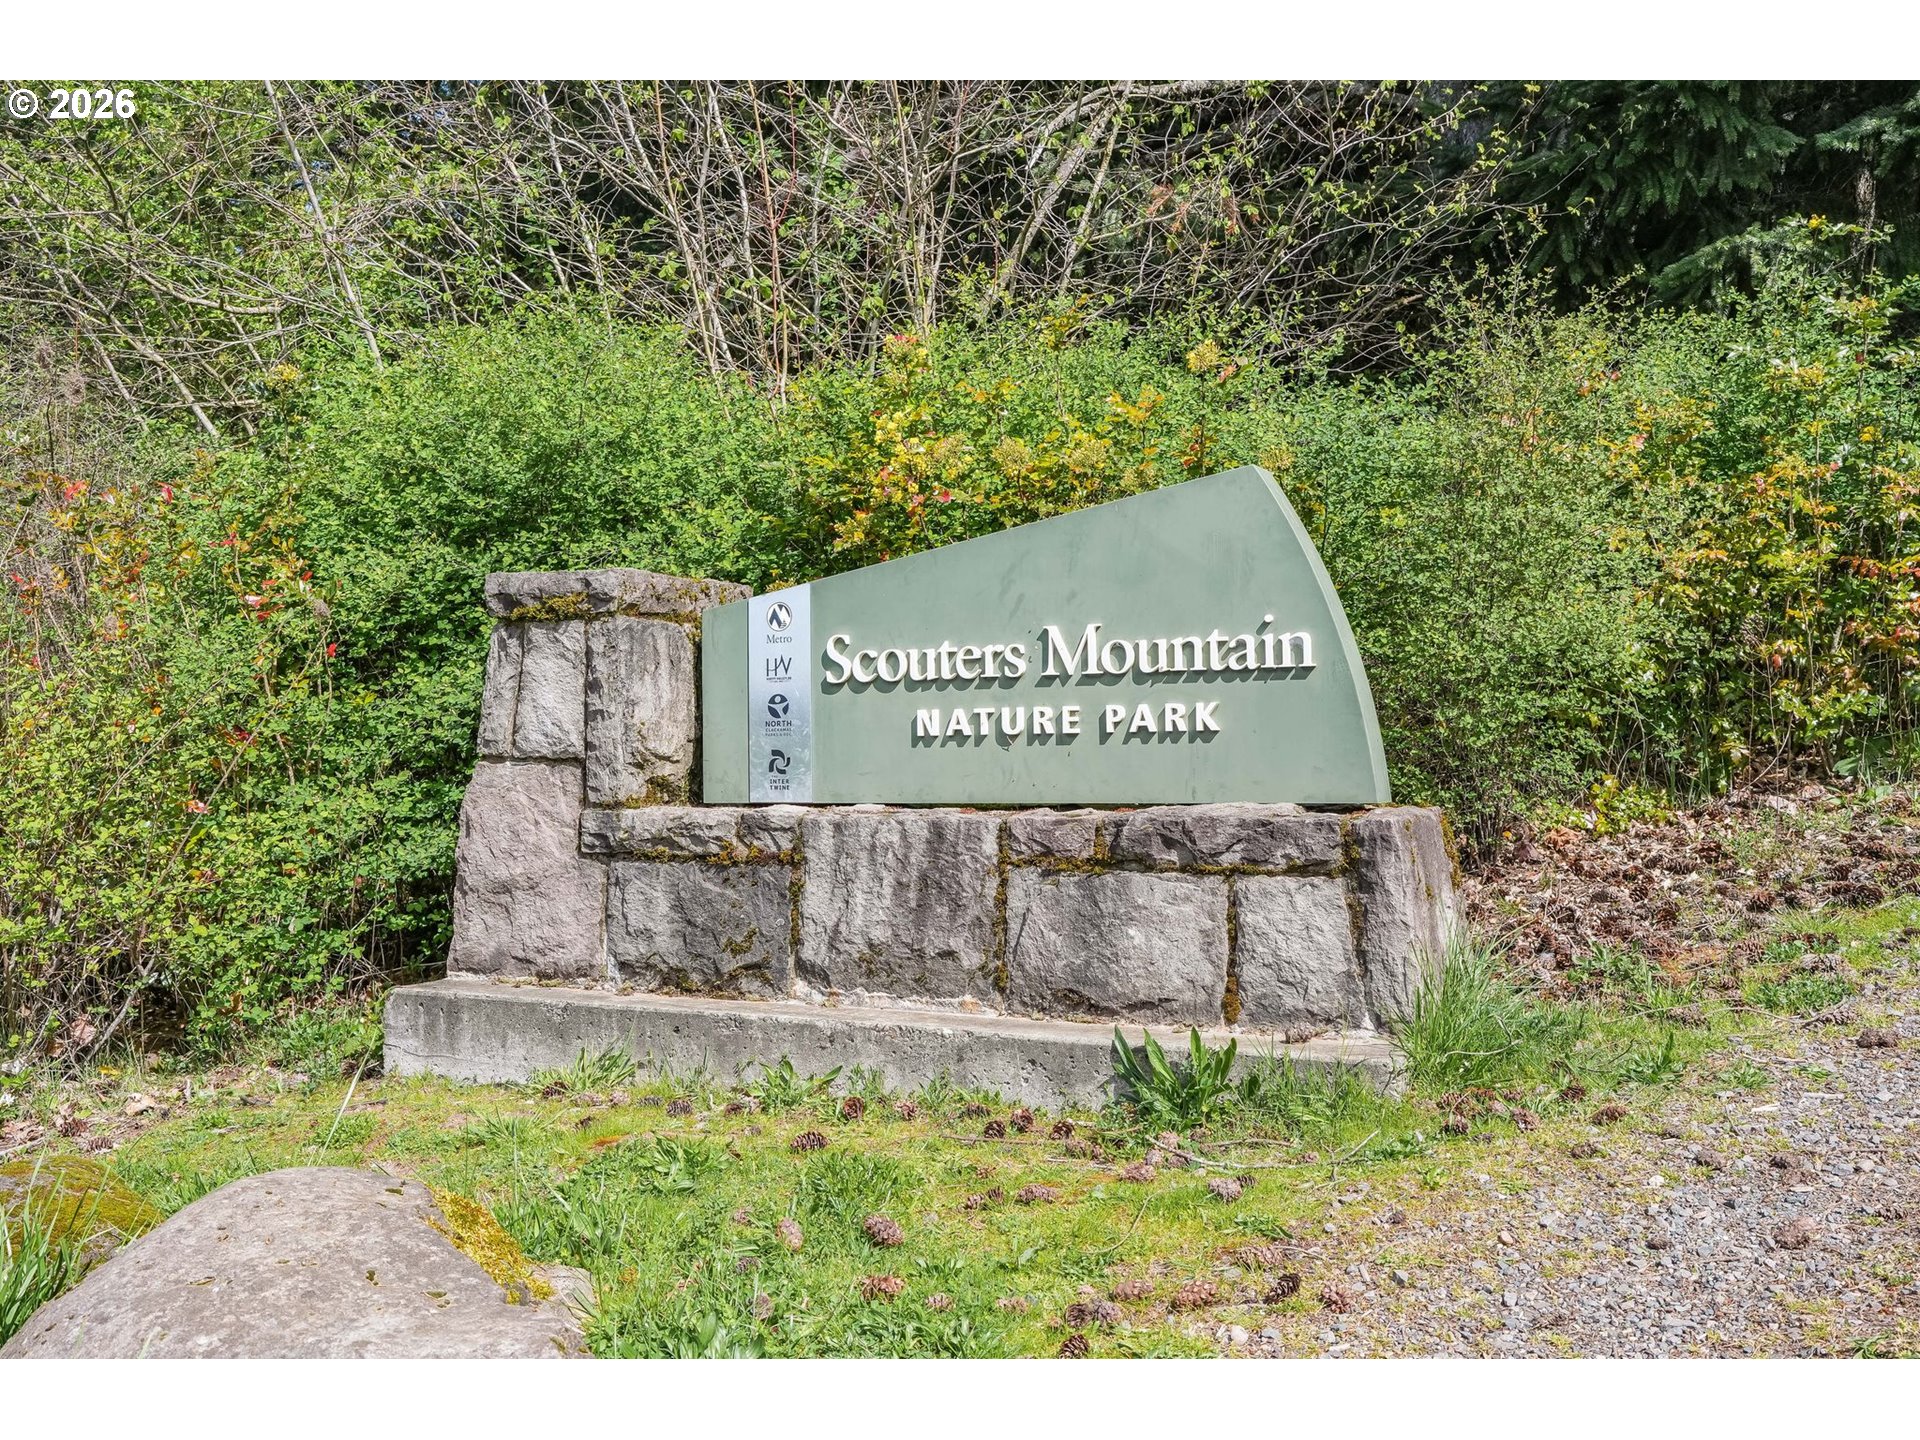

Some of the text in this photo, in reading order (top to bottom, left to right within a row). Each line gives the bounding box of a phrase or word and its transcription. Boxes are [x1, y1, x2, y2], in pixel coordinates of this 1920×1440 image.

[766, 634, 793, 644] Metro
[825, 614, 1317, 685] Scouters Mountain
[916, 701, 1221, 738] NATURE PARK
